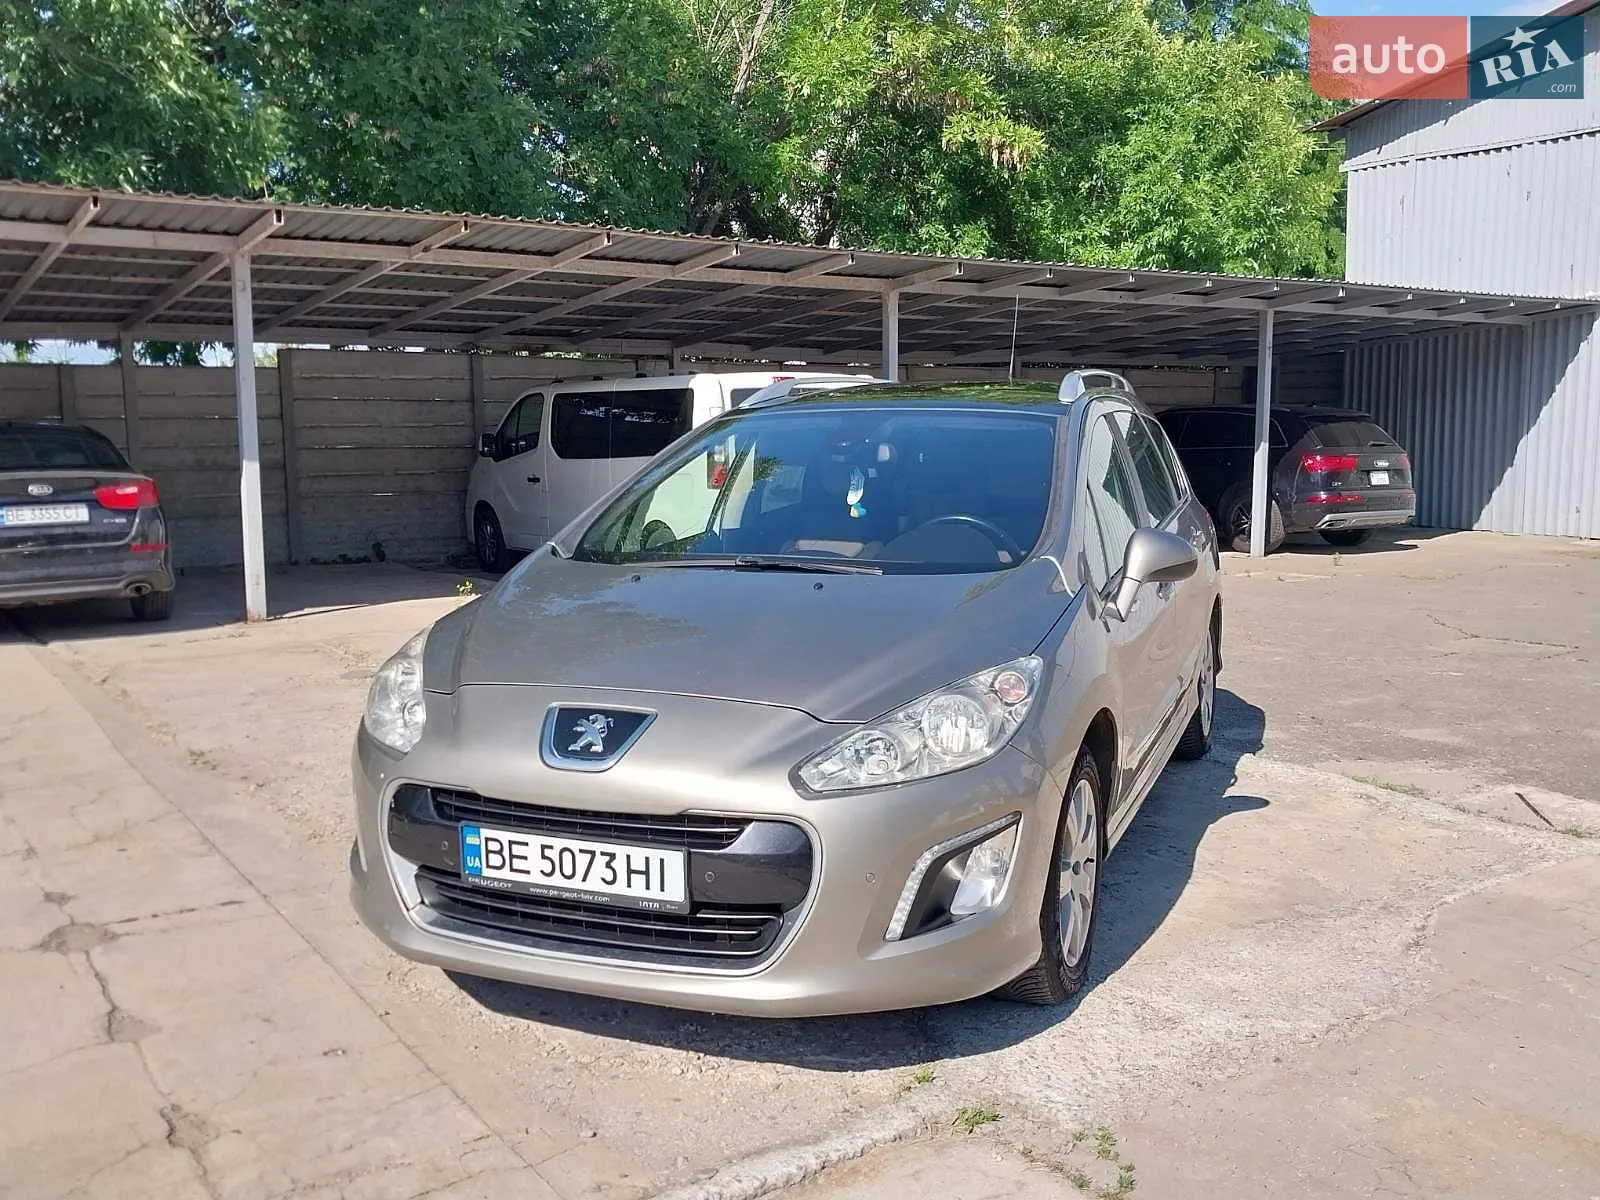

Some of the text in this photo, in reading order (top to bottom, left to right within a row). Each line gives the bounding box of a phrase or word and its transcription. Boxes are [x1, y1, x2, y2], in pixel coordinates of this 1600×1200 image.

[5, 508, 25, 522] BE
[467, 855, 481, 868] UA
[484, 836, 665, 892] BE 5073 HI
